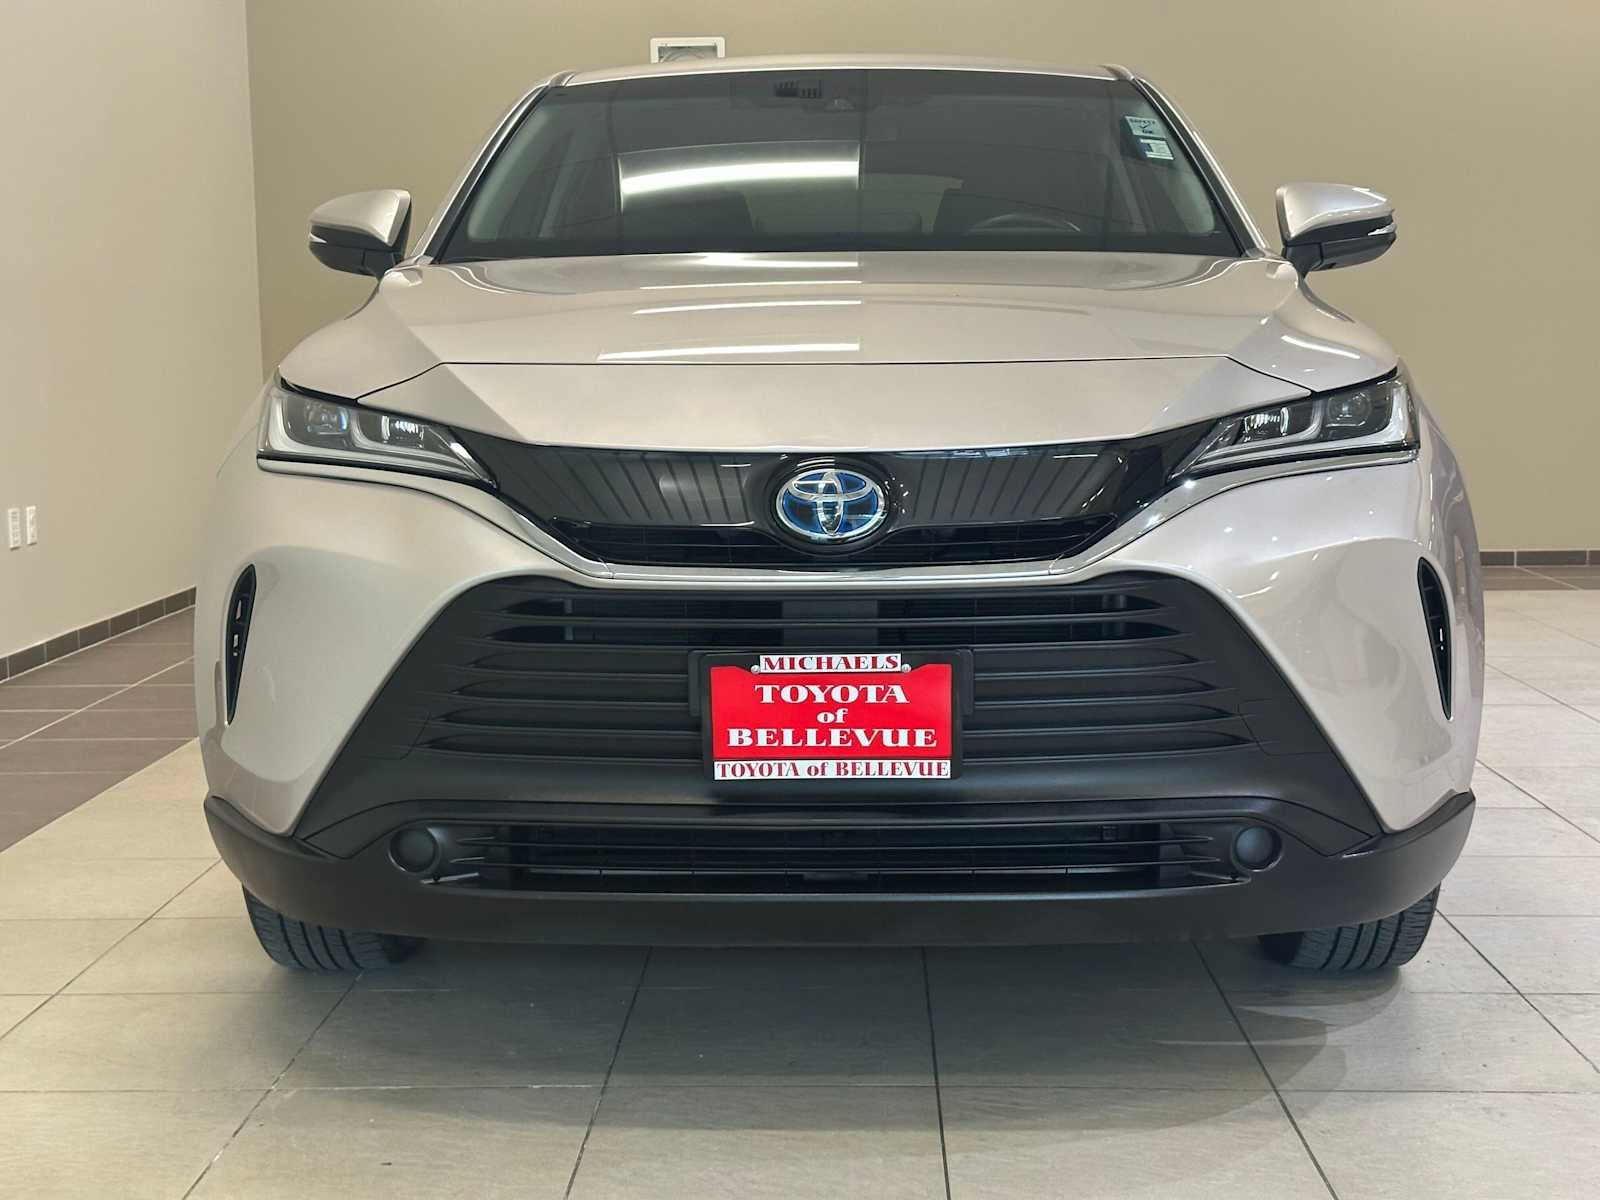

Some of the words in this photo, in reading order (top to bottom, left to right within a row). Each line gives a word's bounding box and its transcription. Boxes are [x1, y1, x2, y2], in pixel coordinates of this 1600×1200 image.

[763, 656, 899, 671] MICHAELS
[755, 684, 909, 704] TOYOTA
[816, 708, 848, 724] of
[727, 728, 937, 747] BELLEVUE
[716, 762, 800, 777] TOYOTA
[807, 762, 829, 777] of
[835, 761, 949, 776] BELLEVUE
